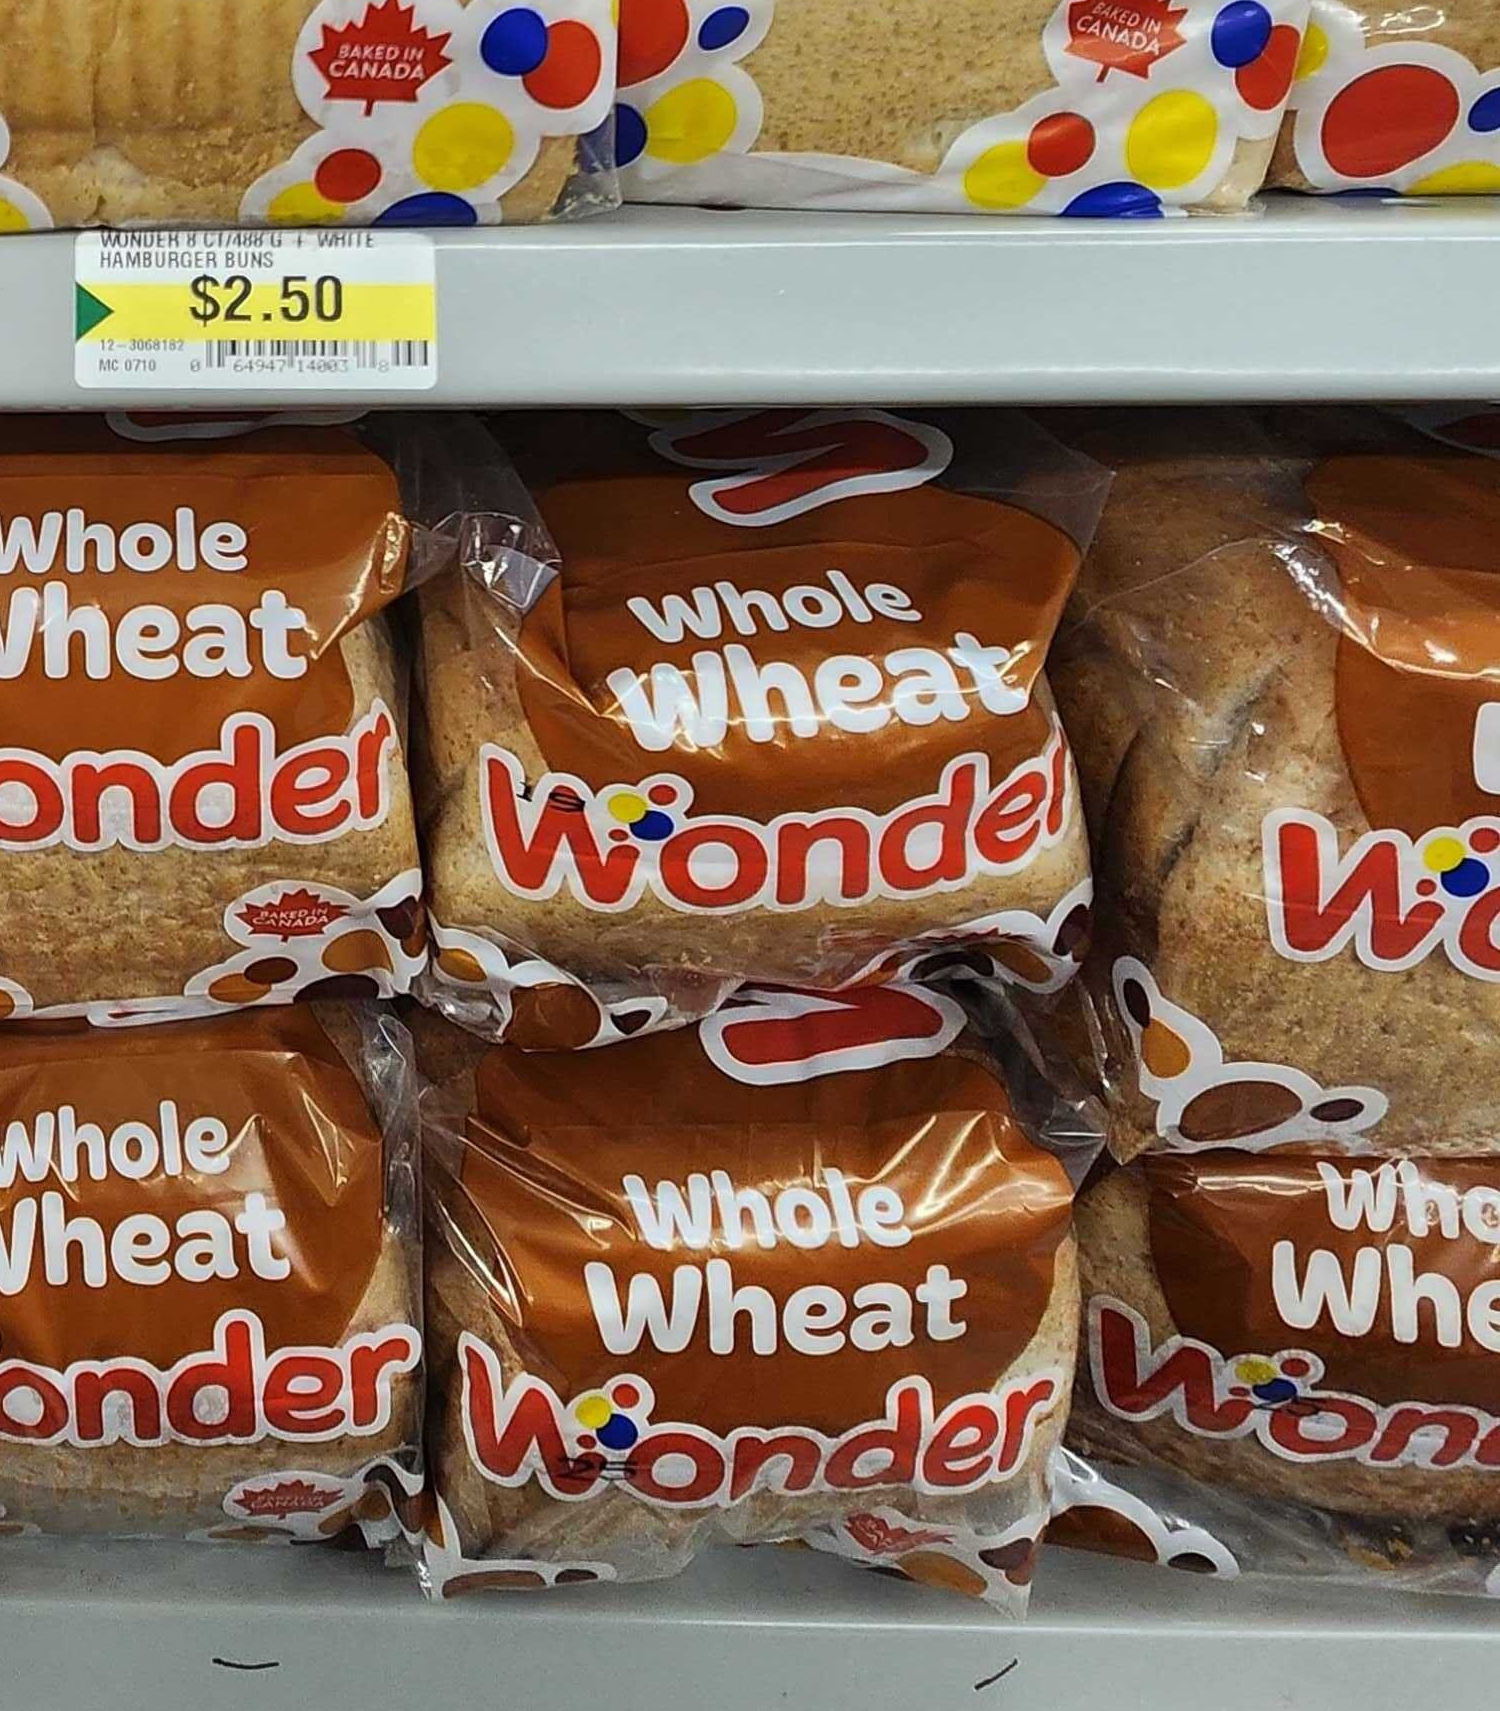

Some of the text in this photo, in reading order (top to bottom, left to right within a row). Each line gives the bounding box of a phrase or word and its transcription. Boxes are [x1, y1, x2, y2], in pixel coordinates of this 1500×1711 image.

[1092, 2, 1162, 34] BAKED IN
[1076, 15, 1161, 56] CANADA
[338, 43, 426, 62] BAKED IN
[328, 59, 427, 81] CANADA
[100, 232, 180, 248] WONDER
[100, 251, 274, 269] HAMBURGER BUNS
[189, 274, 343, 328] $2.50
[99, 359, 157, 372] MC 0710
[233, 359, 286, 373] 64947
[627, 570, 923, 643] Whole
[606, 632, 1030, 752] Wheat
[252, 915, 329, 928] CANADA
[260, 907, 329, 920] BAKED IN
[622, 1168, 914, 1251] Whole
[583, 1259, 968, 1356] Wheat
[466, 1345, 1055, 1502] Wonder
